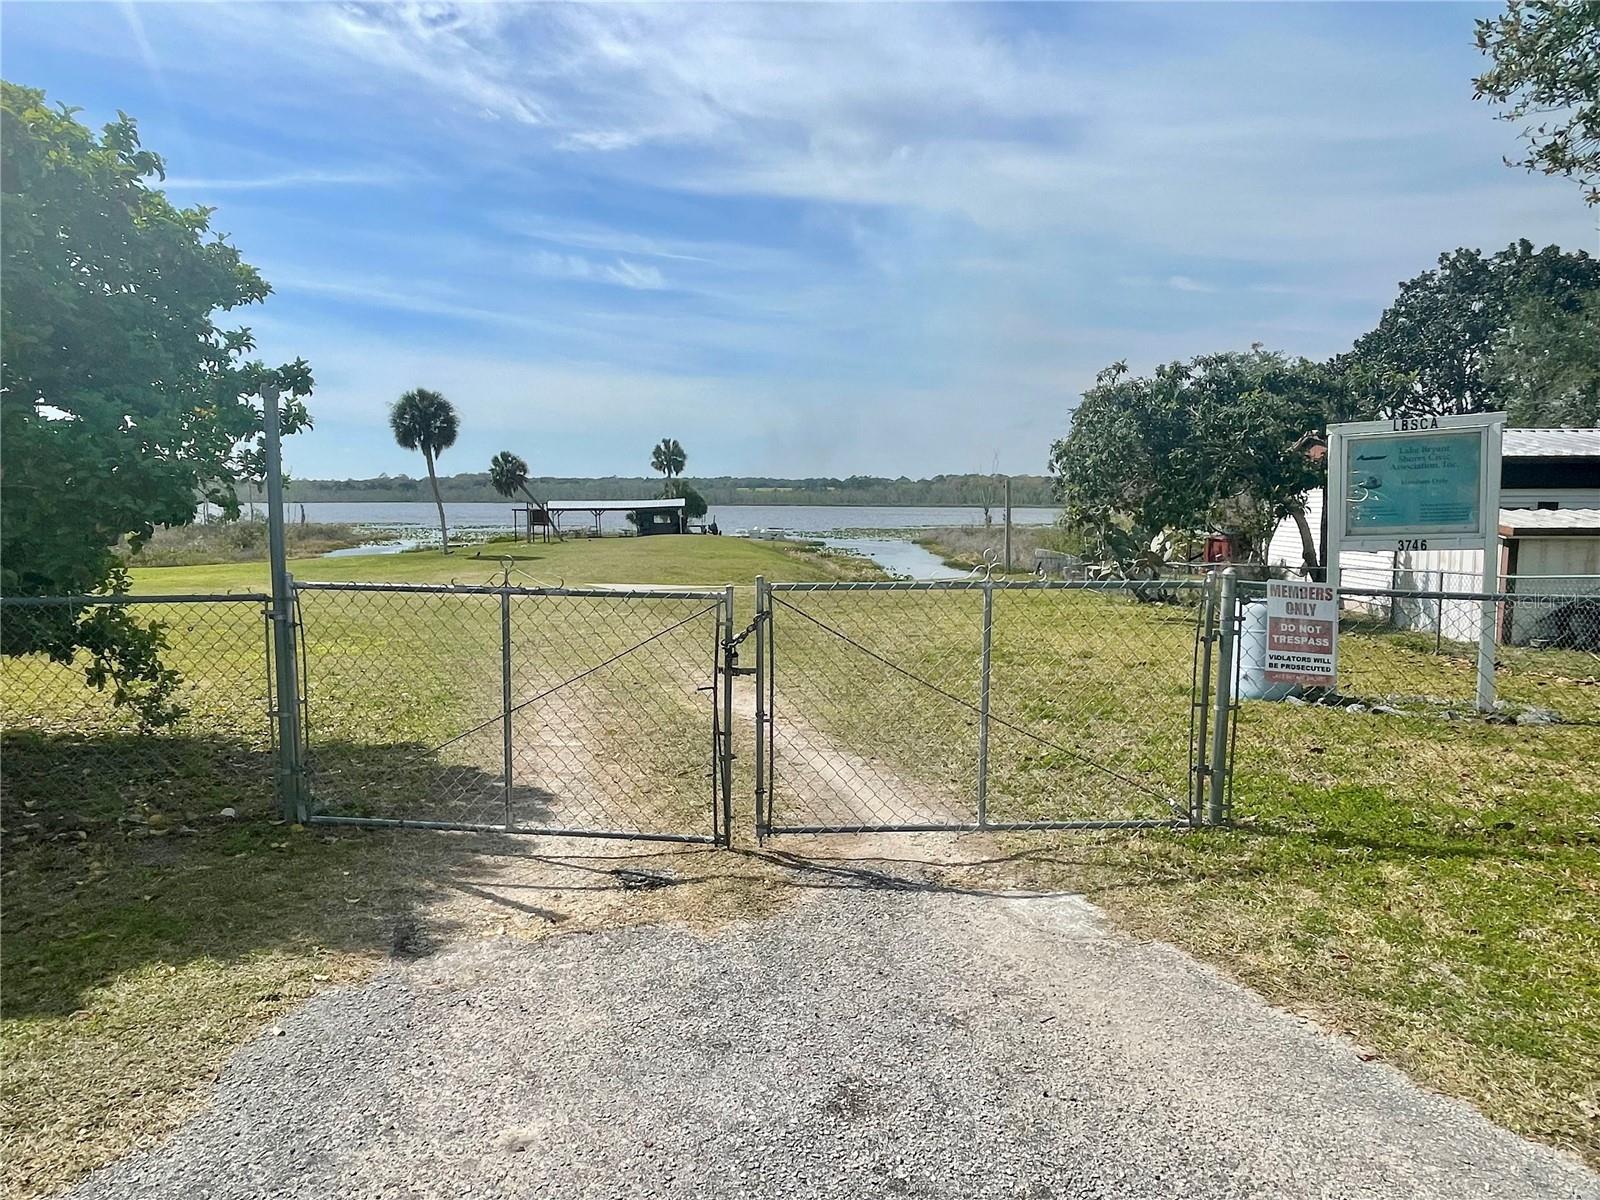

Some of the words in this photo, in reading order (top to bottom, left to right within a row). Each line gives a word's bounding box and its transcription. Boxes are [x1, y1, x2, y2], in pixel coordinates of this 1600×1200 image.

[1393, 417, 1439, 431] LBSCA
[1421, 445, 1450, 455] Bryant
[1397, 539, 1428, 552] 3746
[1270, 583, 1333, 602] MEMBERS
[1285, 600, 1317, 617] ONLY
[1280, 623, 1296, 632] DO
[1298, 625, 1322, 634] NOT
[1271, 634, 1329, 647] TRESPASS
[1268, 654, 1312, 663] VIOLATORS
[1280, 663, 1332, 673] PROSECUTED
